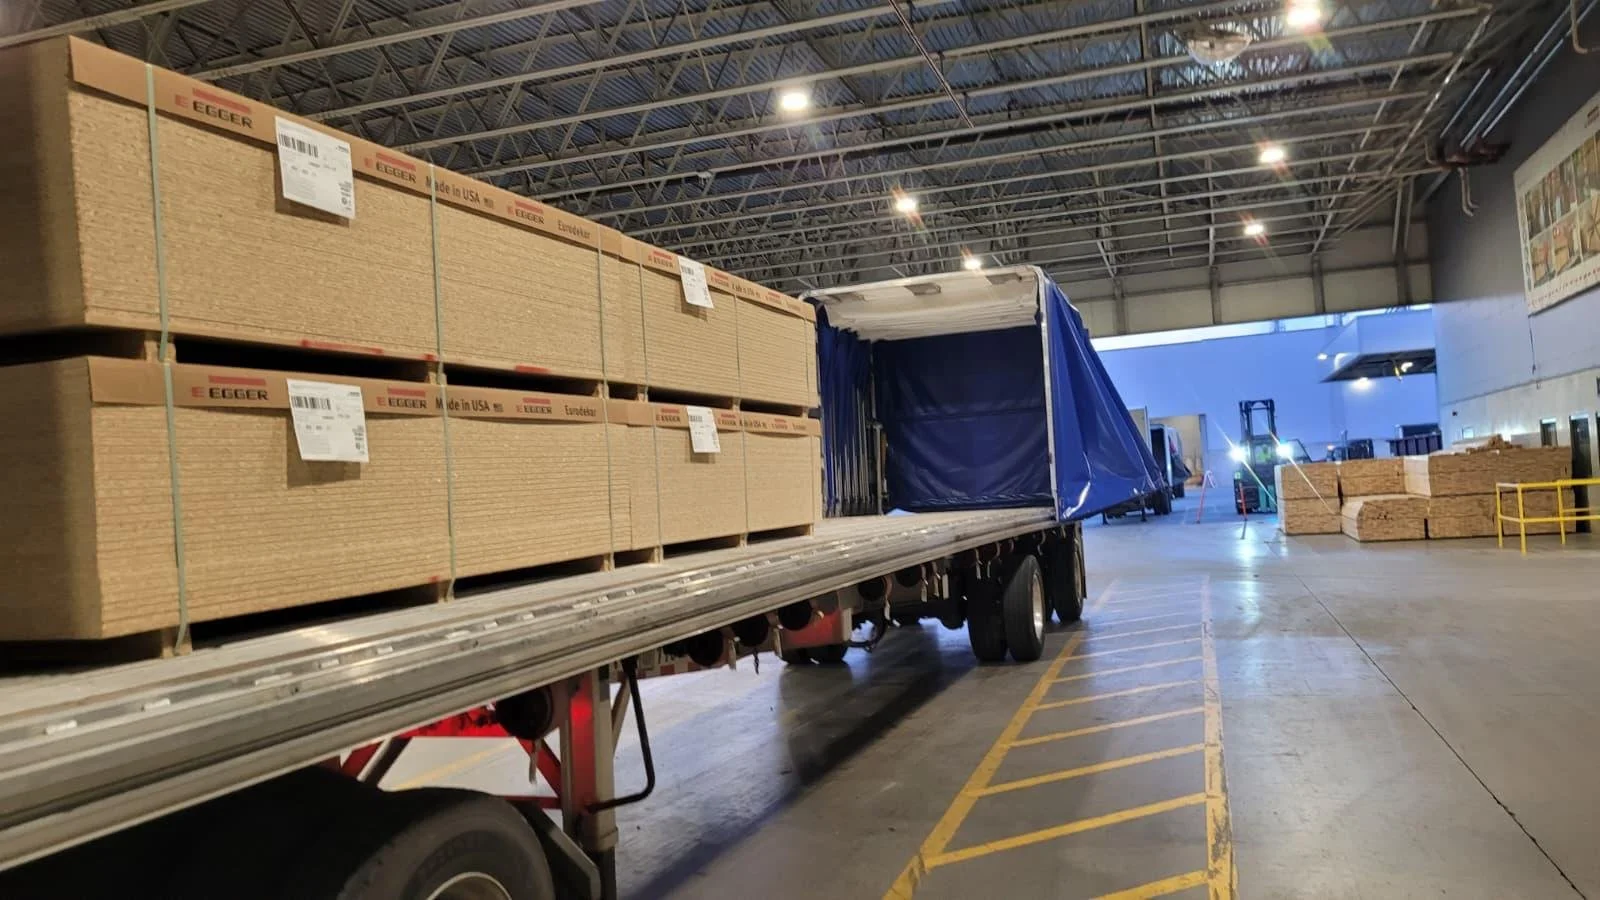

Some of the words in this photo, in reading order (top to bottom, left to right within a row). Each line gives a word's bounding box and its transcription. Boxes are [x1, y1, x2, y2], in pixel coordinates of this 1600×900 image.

[193, 101, 253, 129] EGGER
[376, 161, 417, 184] EGGER
[452, 184, 461, 197] in
[463, 187, 480, 203] USA
[515, 208, 545, 225] EGGER
[209, 387, 269, 401] EGGER
[388, 397, 428, 409] EGGER
[435, 397, 459, 411] Mde
[461, 398, 471, 411] in
[472, 399, 491, 412] USA
